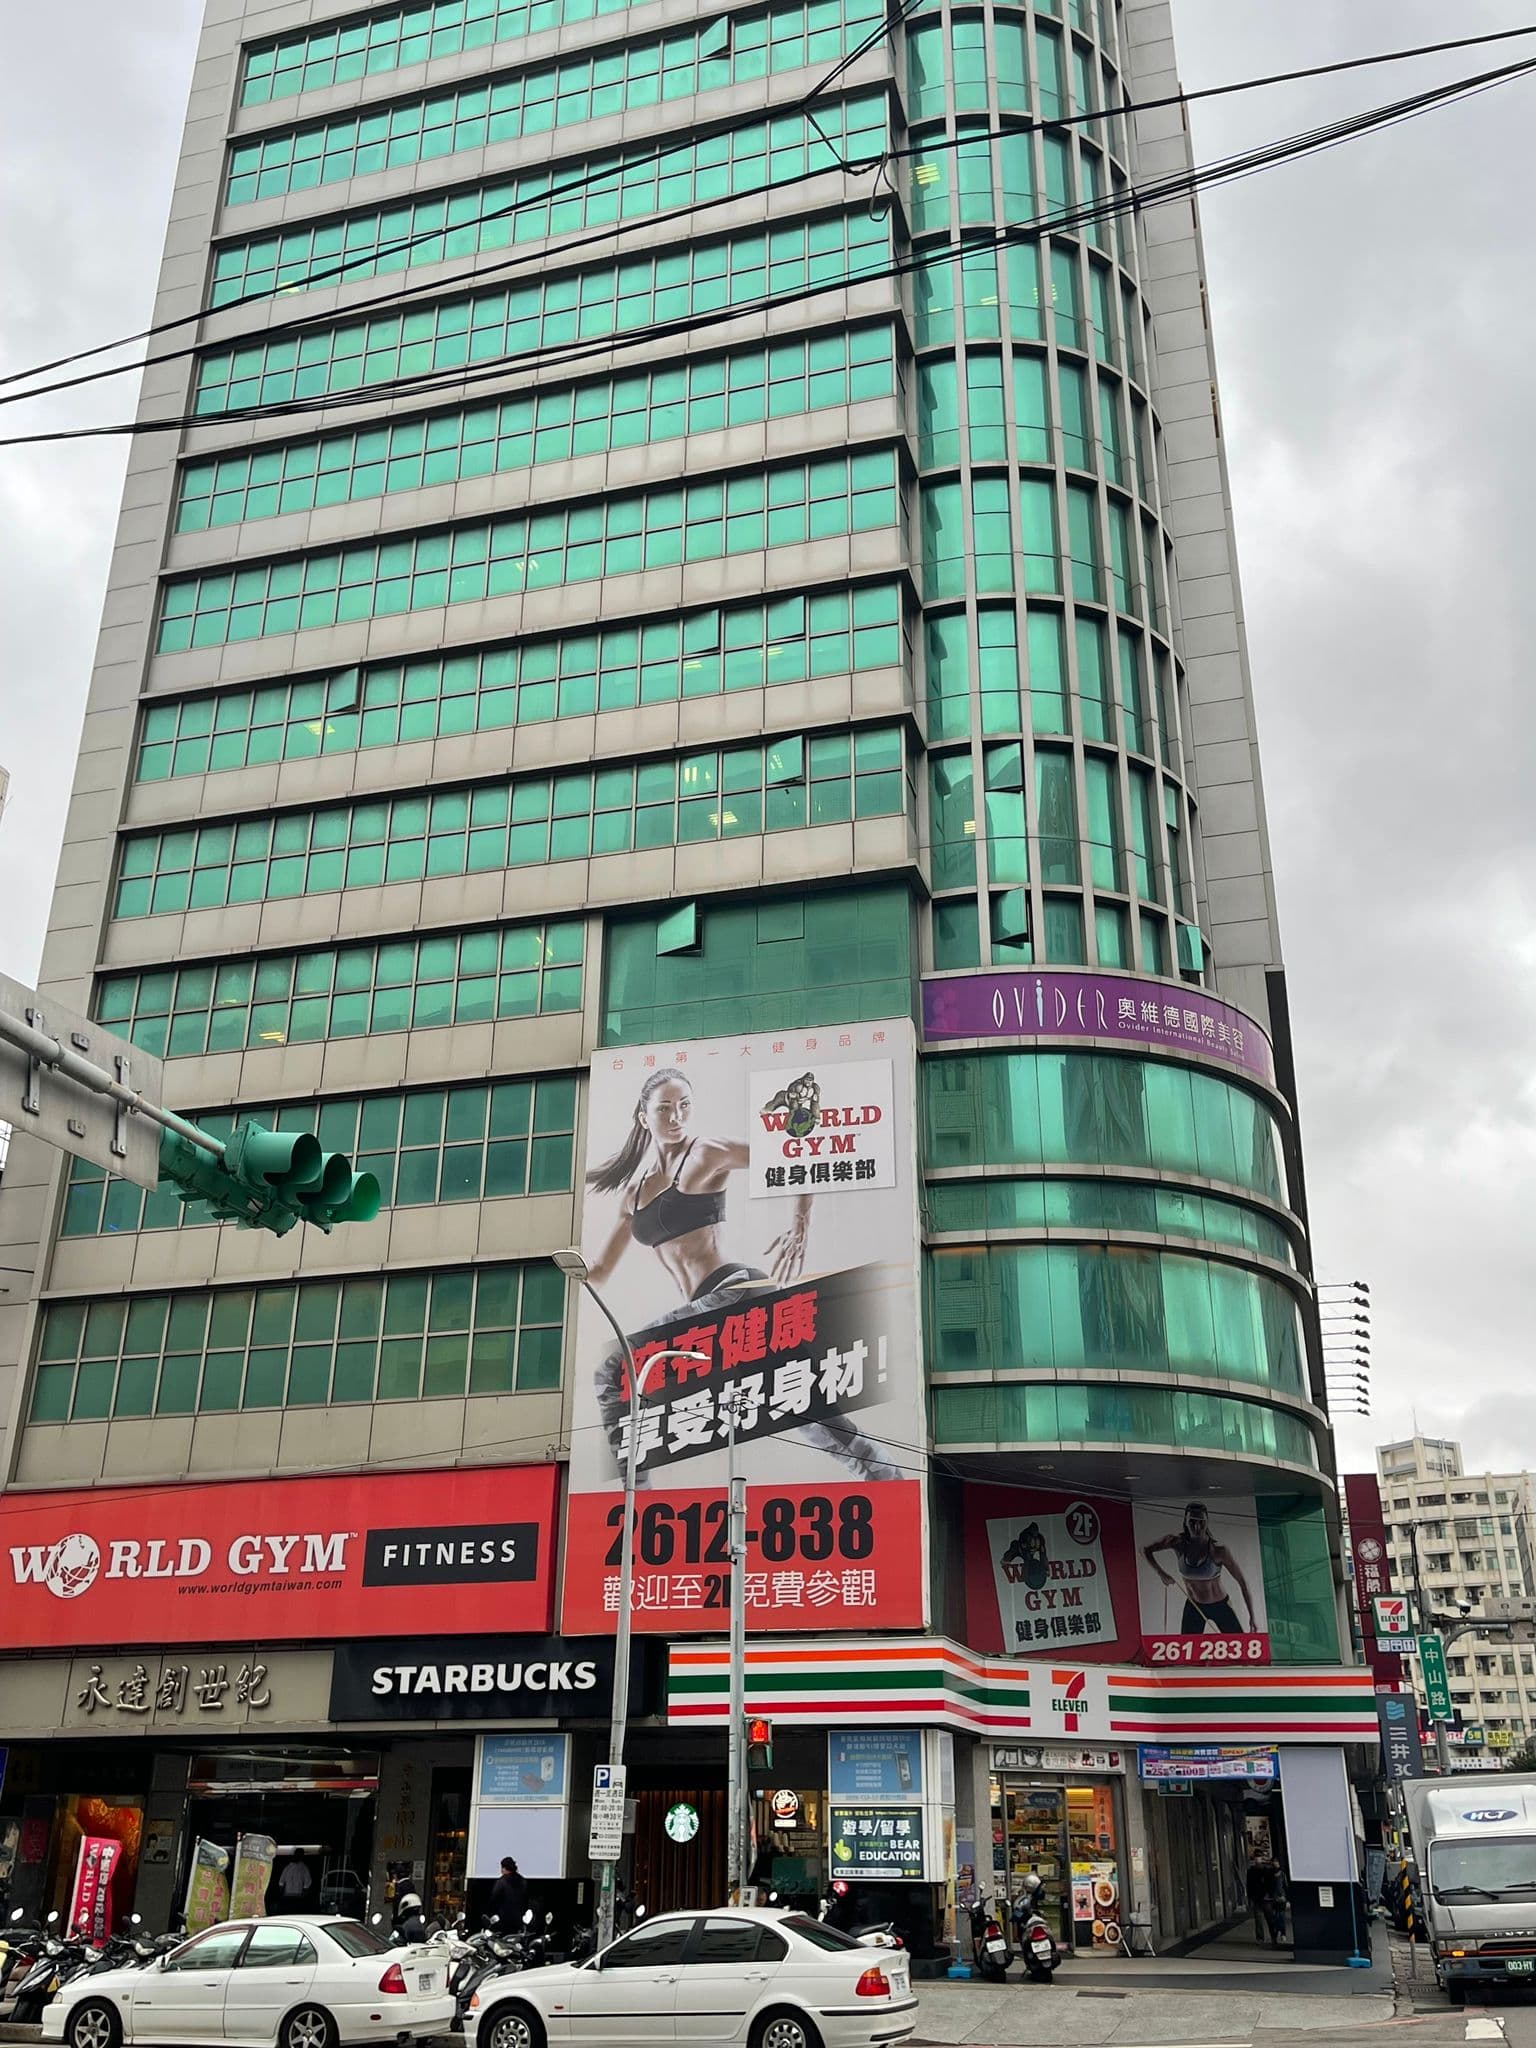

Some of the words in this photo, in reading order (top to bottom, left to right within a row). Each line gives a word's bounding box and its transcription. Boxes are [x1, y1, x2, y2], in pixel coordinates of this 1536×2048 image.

[1118, 998, 1245, 1052] 奧維德國際美容
[1118, 1021, 1149, 1033] Ovider
[1153, 1027, 1204, 1044] International
[612, 1031, 886, 1071] 台灣第一大健身品牌
[760, 1105, 882, 1138] WORLD
[782, 1133, 857, 1158] GYM
[764, 1158, 876, 1188] 健身俱樂部
[618, 1290, 819, 1403] 擁有健康
[1072, 1511, 1093, 1537] 2F
[9, 1534, 212, 1594] WORLD
[227, 1532, 350, 1576] GYM
[383, 1539, 516, 1567] FITNESS
[177, 1579, 343, 1597] www.worldgymtaiwan.com
[1024, 1586, 1083, 1611] GYM
[1015, 1611, 1102, 1643] 健身俱樂部
[77, 1664, 272, 1714] 永達創世紀
[371, 1661, 597, 1695] STARBUCKS
[1425, 1647, 1446, 1706] 中山路
[596, 1769, 609, 1788] P
[842, 1819, 911, 1836] 遊學/留學
[1469, 1810, 1507, 1821] HCT
[859, 1851, 920, 1861] EDUCATION
[889, 1839, 920, 1849] BEAR
